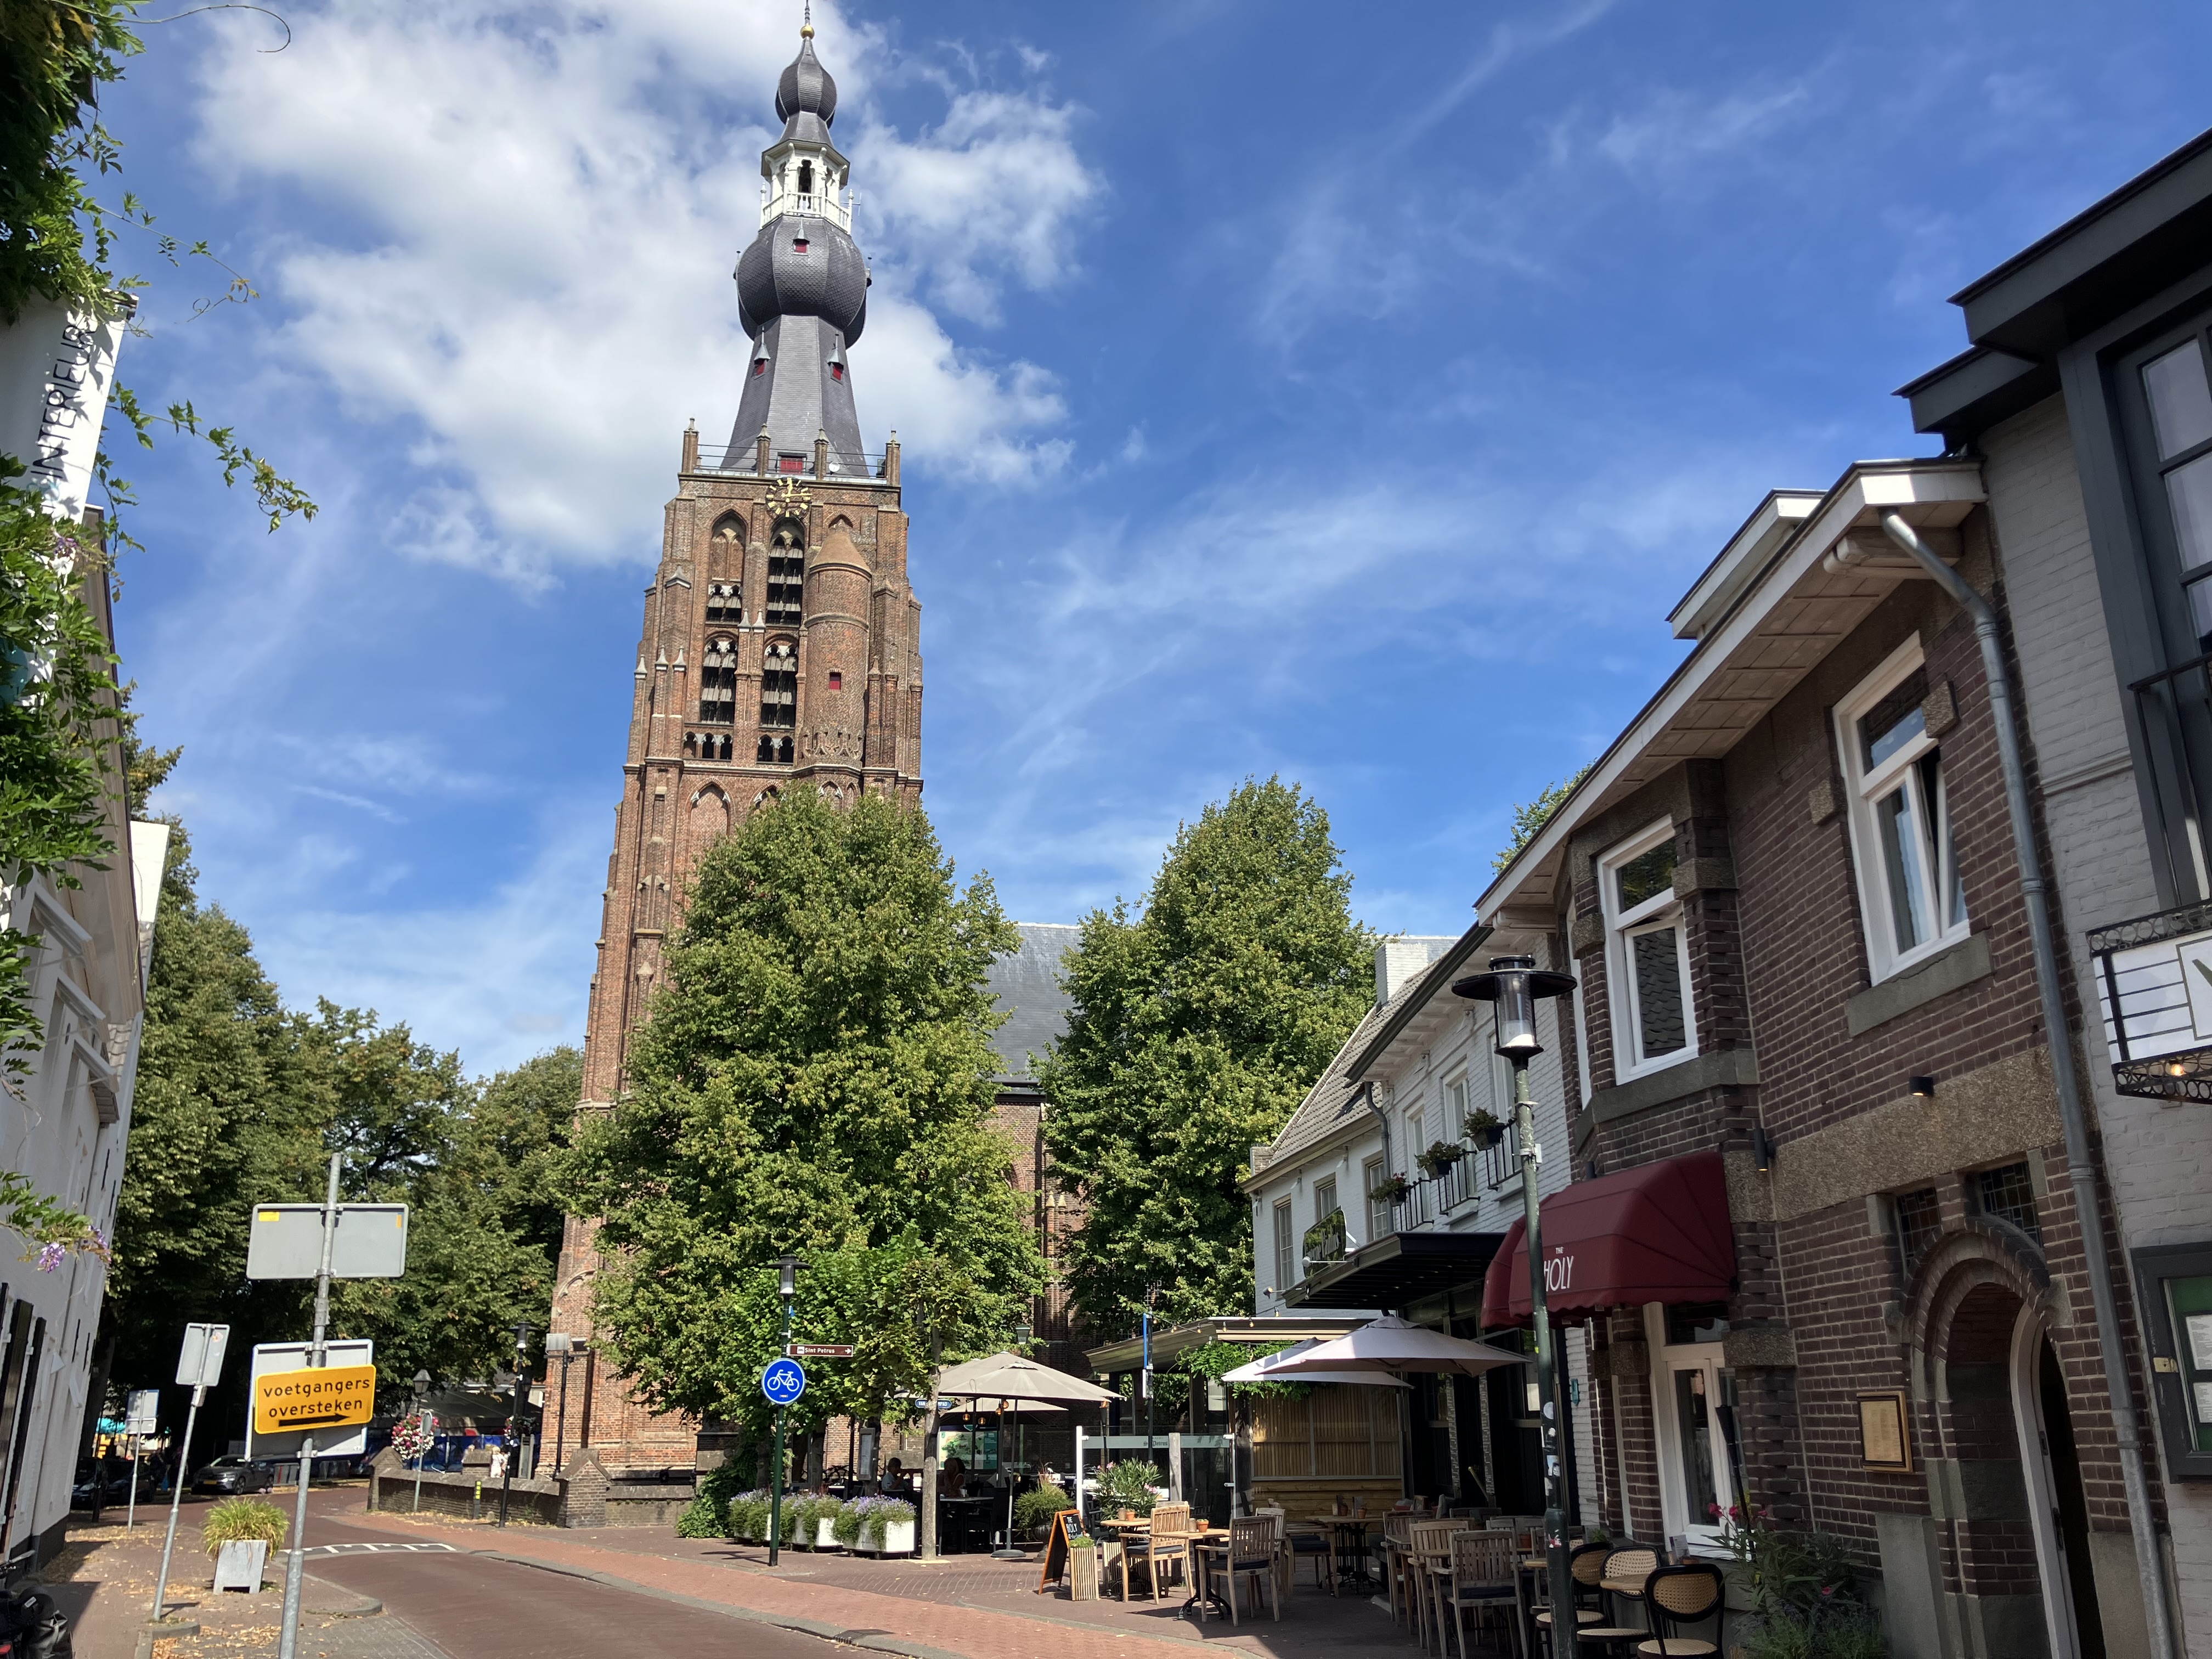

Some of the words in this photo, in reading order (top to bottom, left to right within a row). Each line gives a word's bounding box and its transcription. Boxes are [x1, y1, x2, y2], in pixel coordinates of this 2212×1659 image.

[30, 324, 98, 479] INTERIEUR
[1544, 1256, 1574, 1292] HOLY
[264, 1379, 370, 1397] voetgangers
[269, 1400, 363, 1418] oversteken
